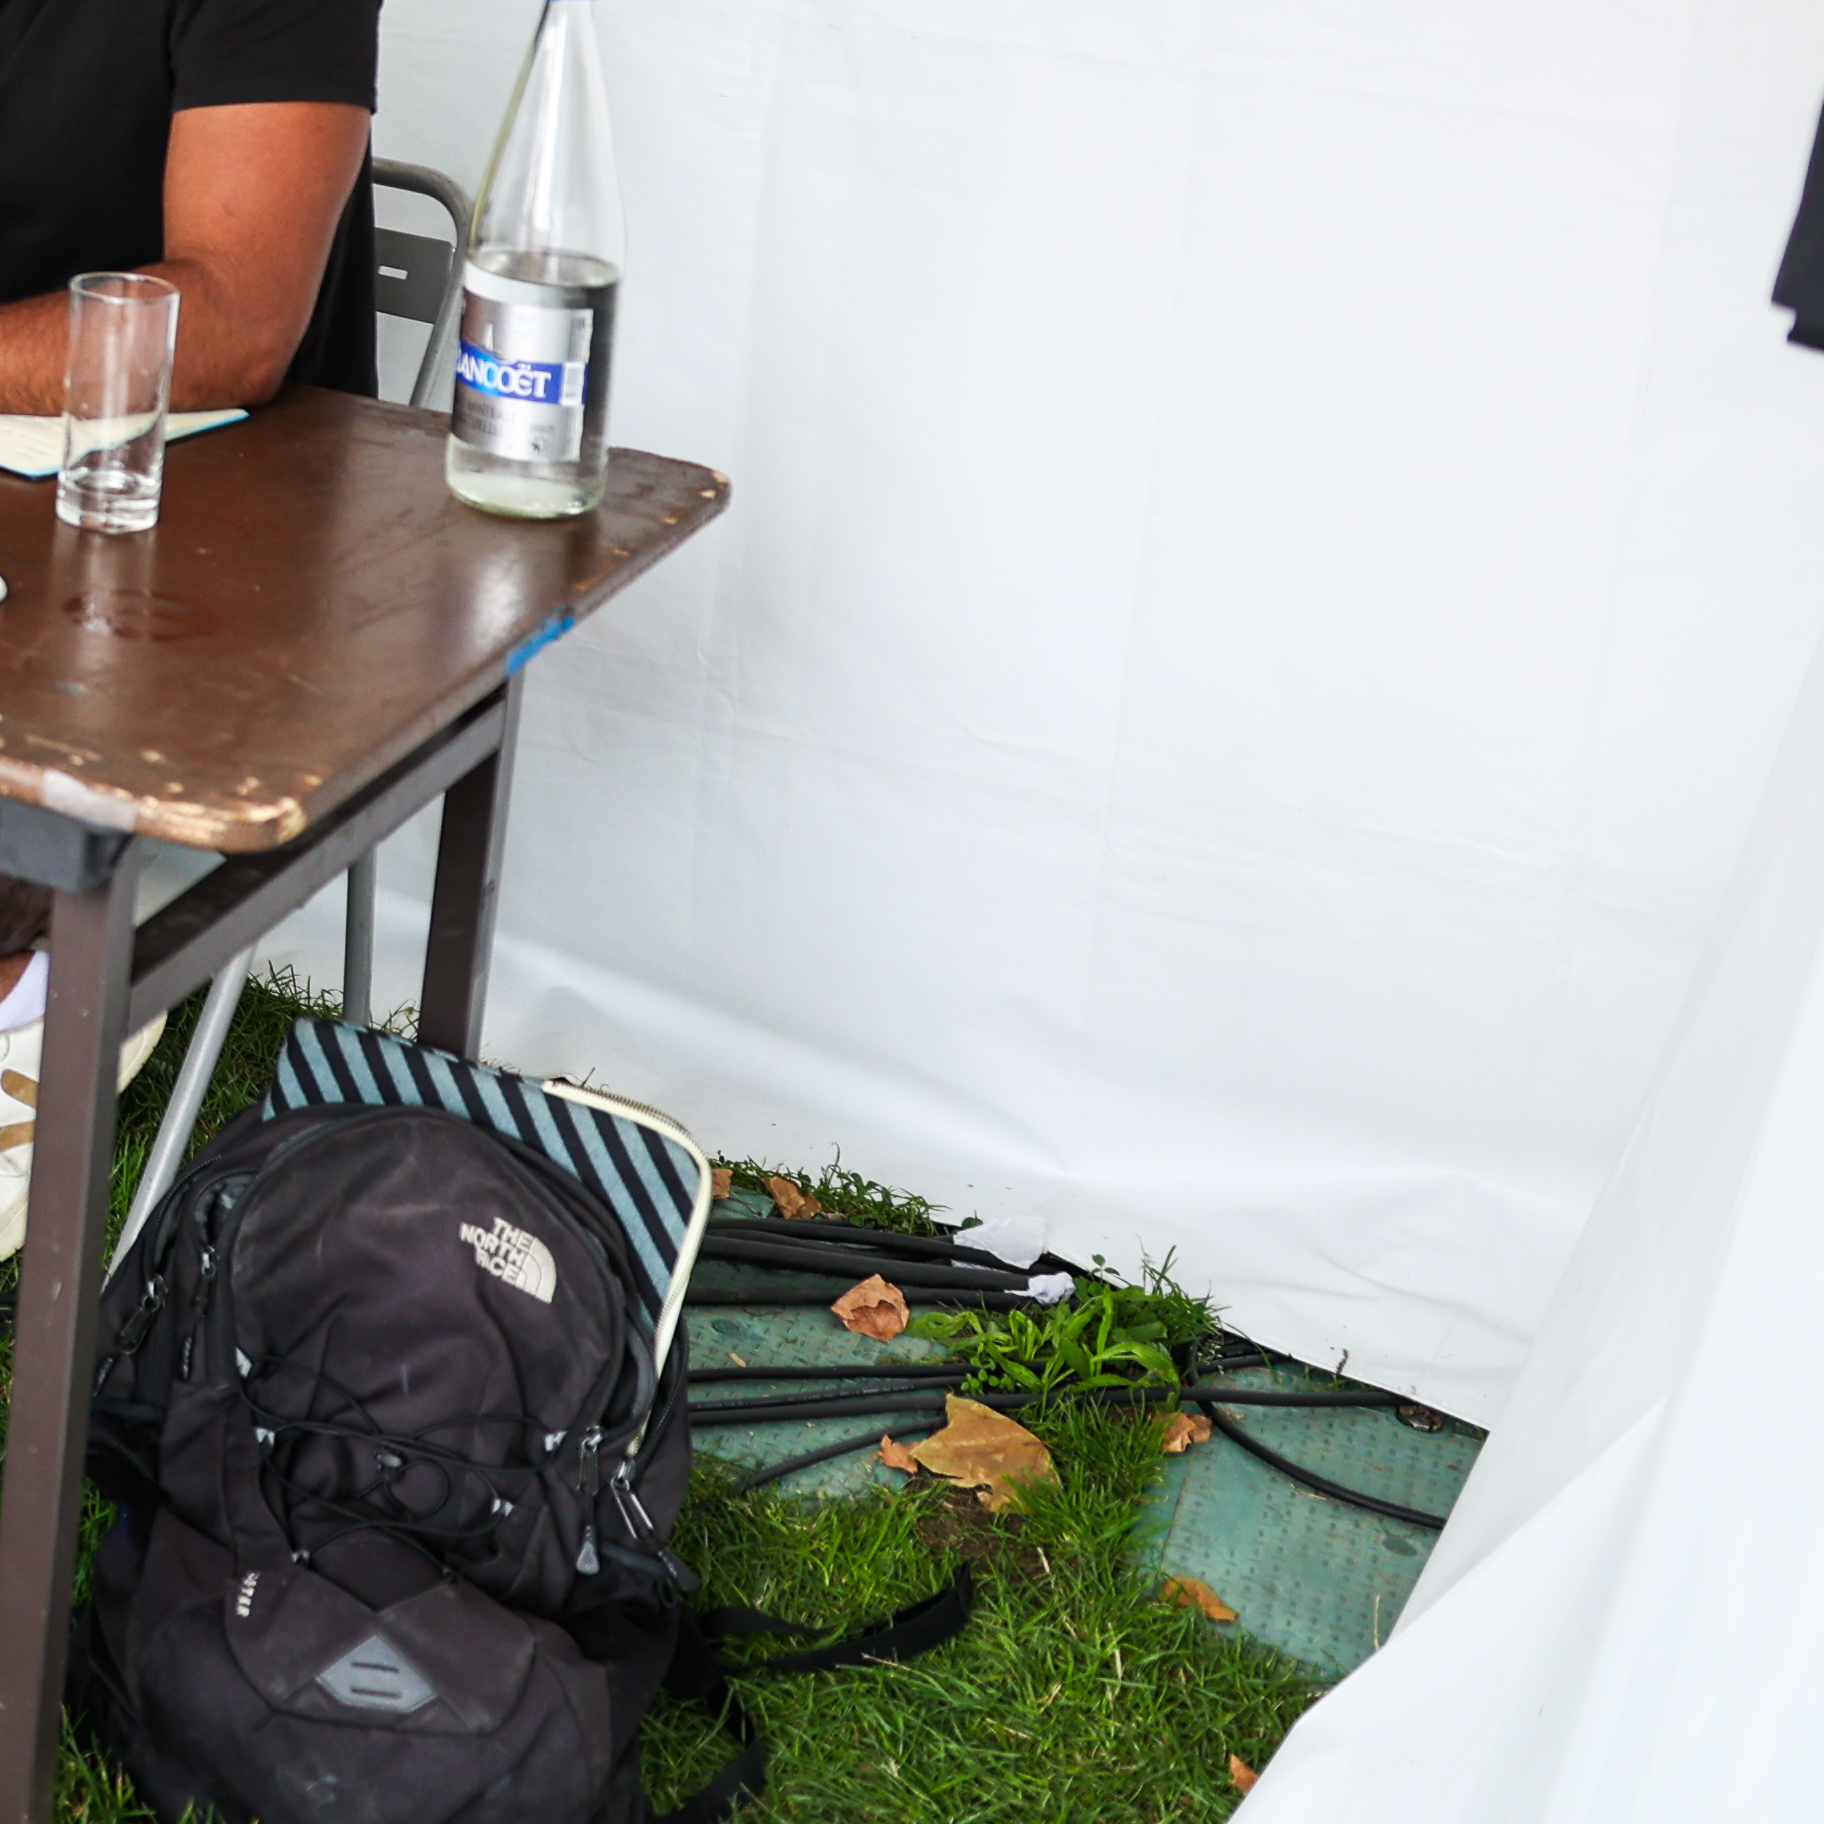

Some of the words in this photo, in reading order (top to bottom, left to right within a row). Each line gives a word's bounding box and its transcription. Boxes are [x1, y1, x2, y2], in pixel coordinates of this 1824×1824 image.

[460, 1222, 528, 1270] NORTH
[494, 1216, 533, 1254] THE
[475, 1247, 522, 1286] FACE
